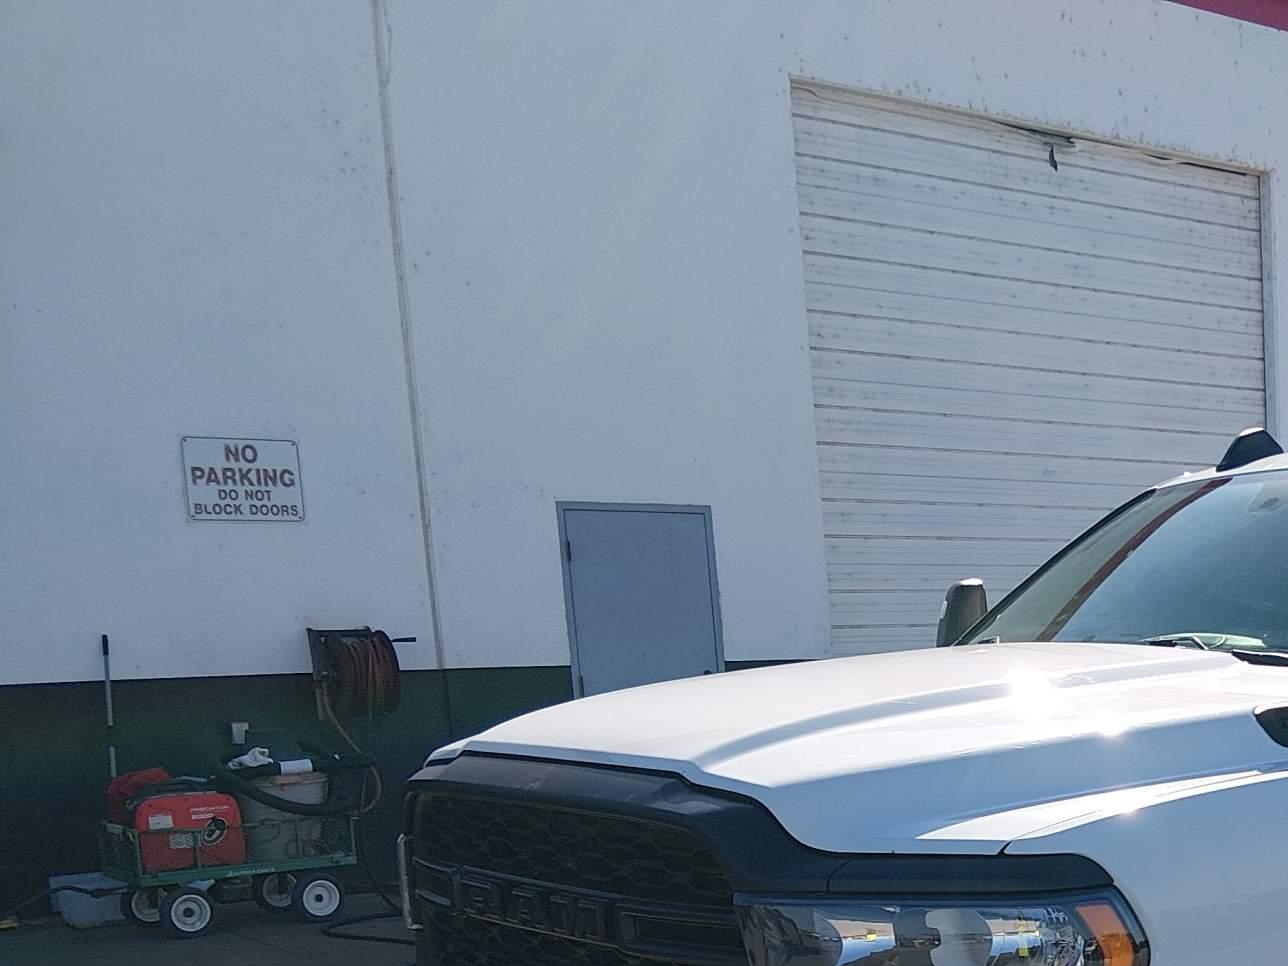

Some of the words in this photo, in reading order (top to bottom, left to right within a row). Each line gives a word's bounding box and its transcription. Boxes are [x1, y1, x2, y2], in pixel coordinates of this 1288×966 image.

[224, 444, 258, 464] NO
[191, 466, 296, 488] PARKING
[218, 489, 239, 501] DO
[244, 490, 273, 502] NOT
[194, 503, 244, 515] BLOCK
[249, 504, 299, 517] DOORS
